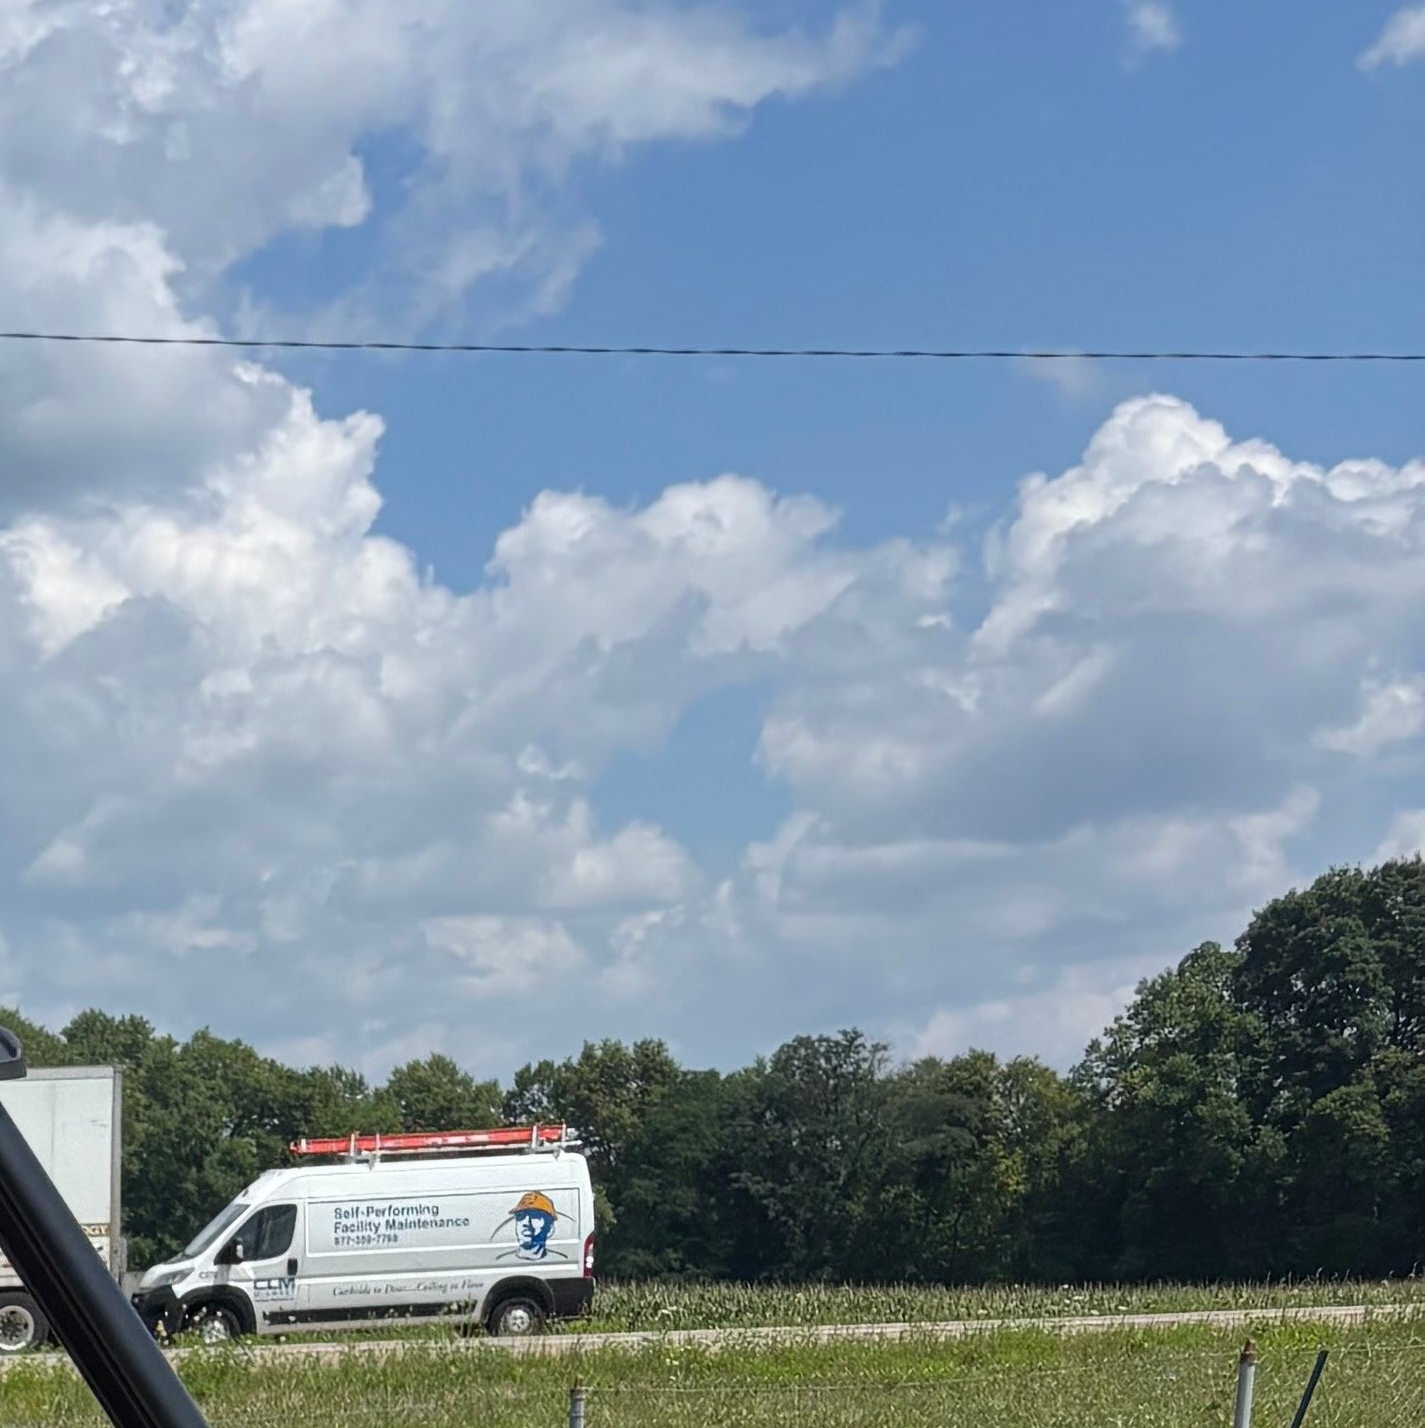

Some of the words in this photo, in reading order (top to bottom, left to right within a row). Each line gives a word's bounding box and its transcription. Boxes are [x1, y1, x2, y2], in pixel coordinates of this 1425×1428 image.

[334, 1204, 440, 1219] Self-Performing
[334, 1221, 381, 1235] Facility
[385, 1217, 470, 1231] Maintenance
